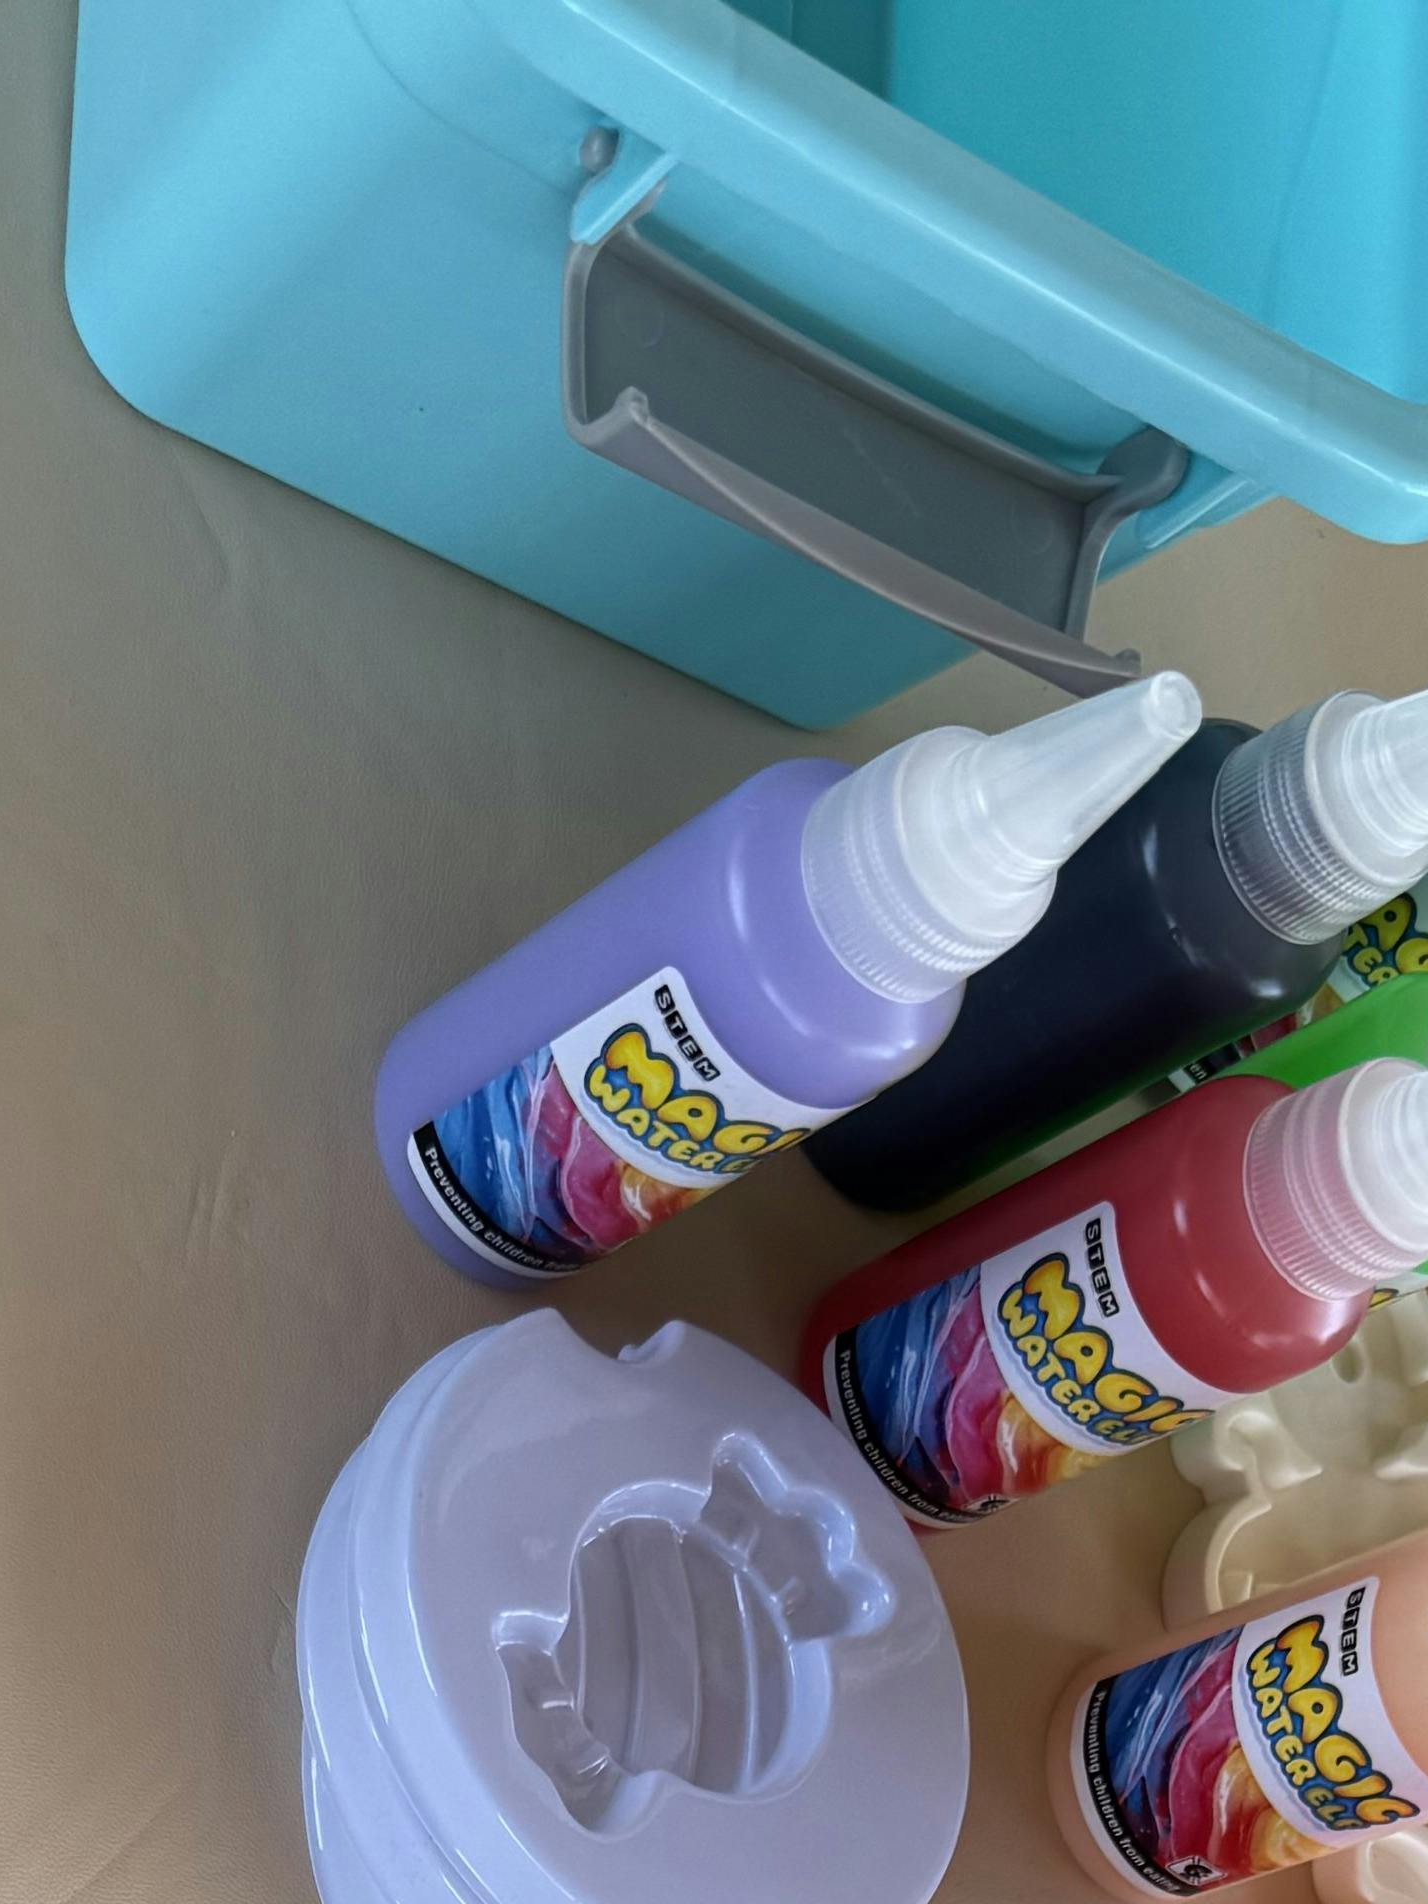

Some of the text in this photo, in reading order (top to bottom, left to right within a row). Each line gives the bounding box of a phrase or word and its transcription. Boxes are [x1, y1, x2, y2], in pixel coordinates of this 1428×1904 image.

[654, 984, 720, 1081] STEM
[586, 1063, 722, 1172] WATER
[602, 1023, 811, 1156] MAGI
[423, 1146, 544, 1269] Preventing children
[1084, 1218, 1120, 1318] STEM
[999, 1287, 1103, 1424] WATER
[1022, 1253, 1216, 1434] MAGIC
[838, 1349, 940, 1519] Preventing children from
[1339, 1586, 1367, 1677] STEM
[1086, 1690, 1106, 1773] Preventing
[1248, 1642, 1317, 1789] WATER
[1276, 1614, 1421, 1825] MAGIC
[1092, 1774, 1125, 1837] children
[1118, 1837, 1146, 1871] from
[1300, 1787, 1371, 1831] ELF
